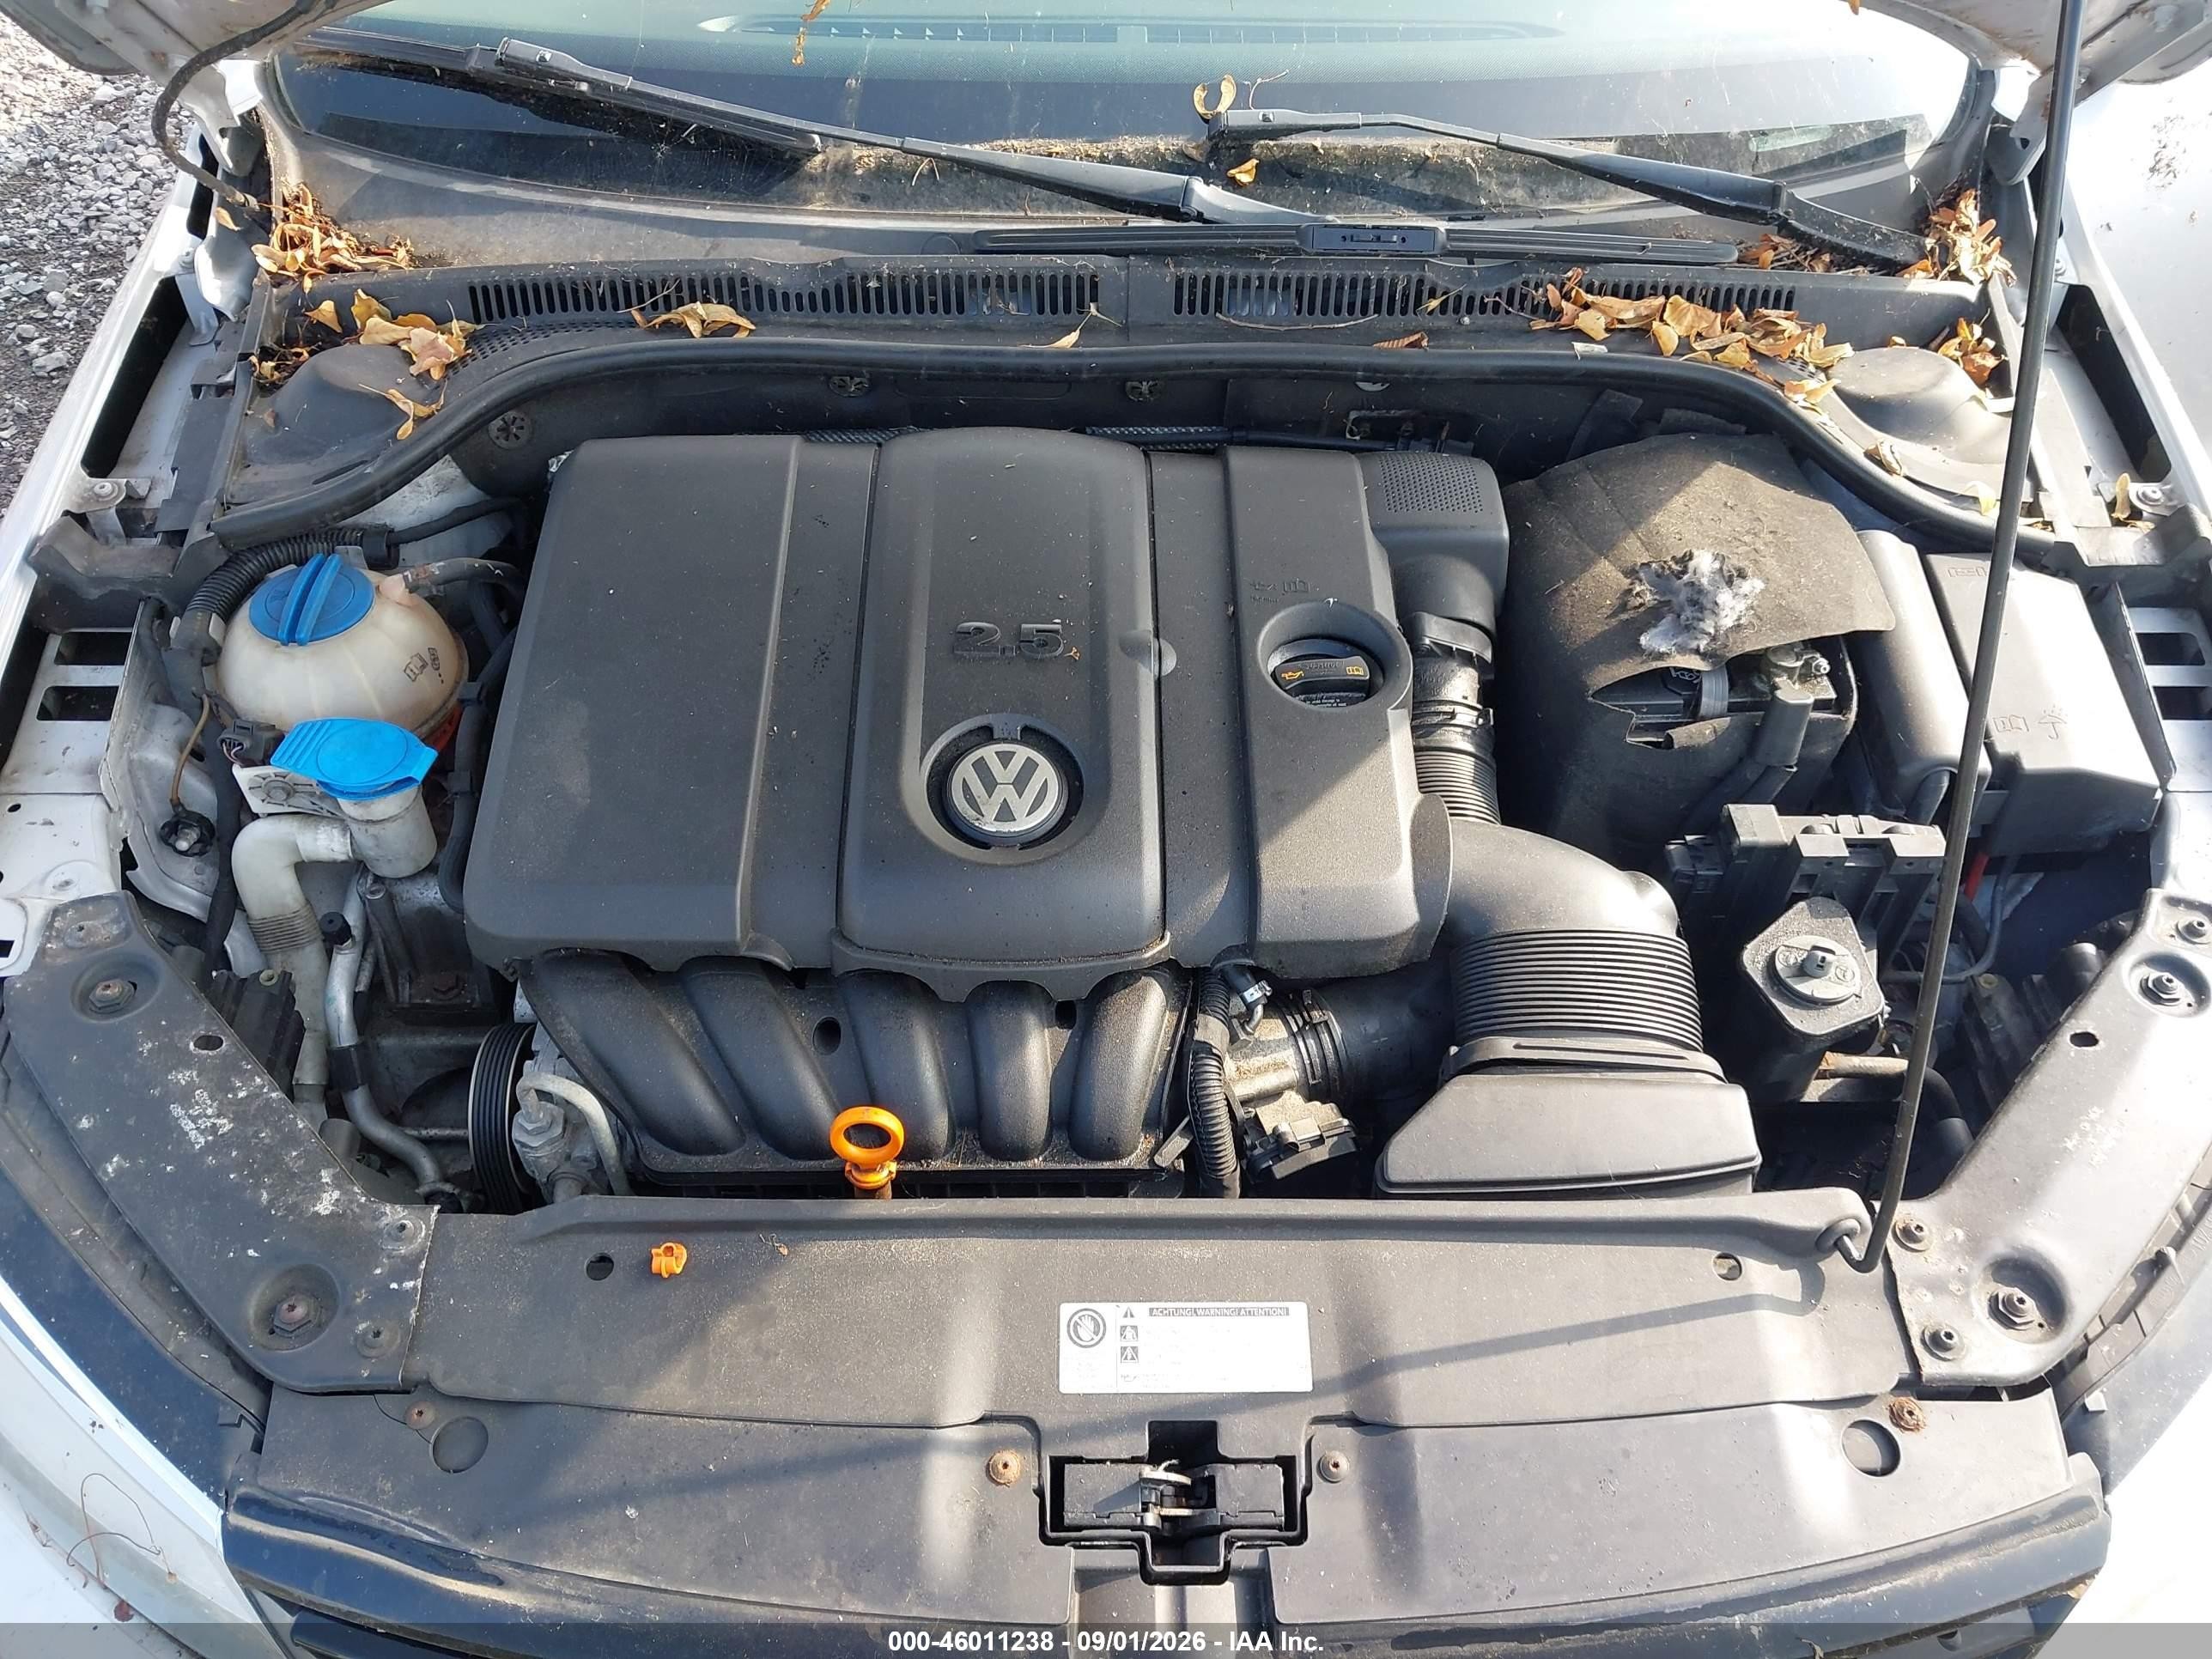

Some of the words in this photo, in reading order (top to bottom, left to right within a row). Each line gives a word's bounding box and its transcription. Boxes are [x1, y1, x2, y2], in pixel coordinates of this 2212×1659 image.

[953, 621, 1064, 659] 2.5
[1152, 1307, 1195, 1316] ACHTUNG!
[1196, 1307, 1238, 1316] WARNING!
[1240, 1306, 1287, 1316] ATTENTION!
